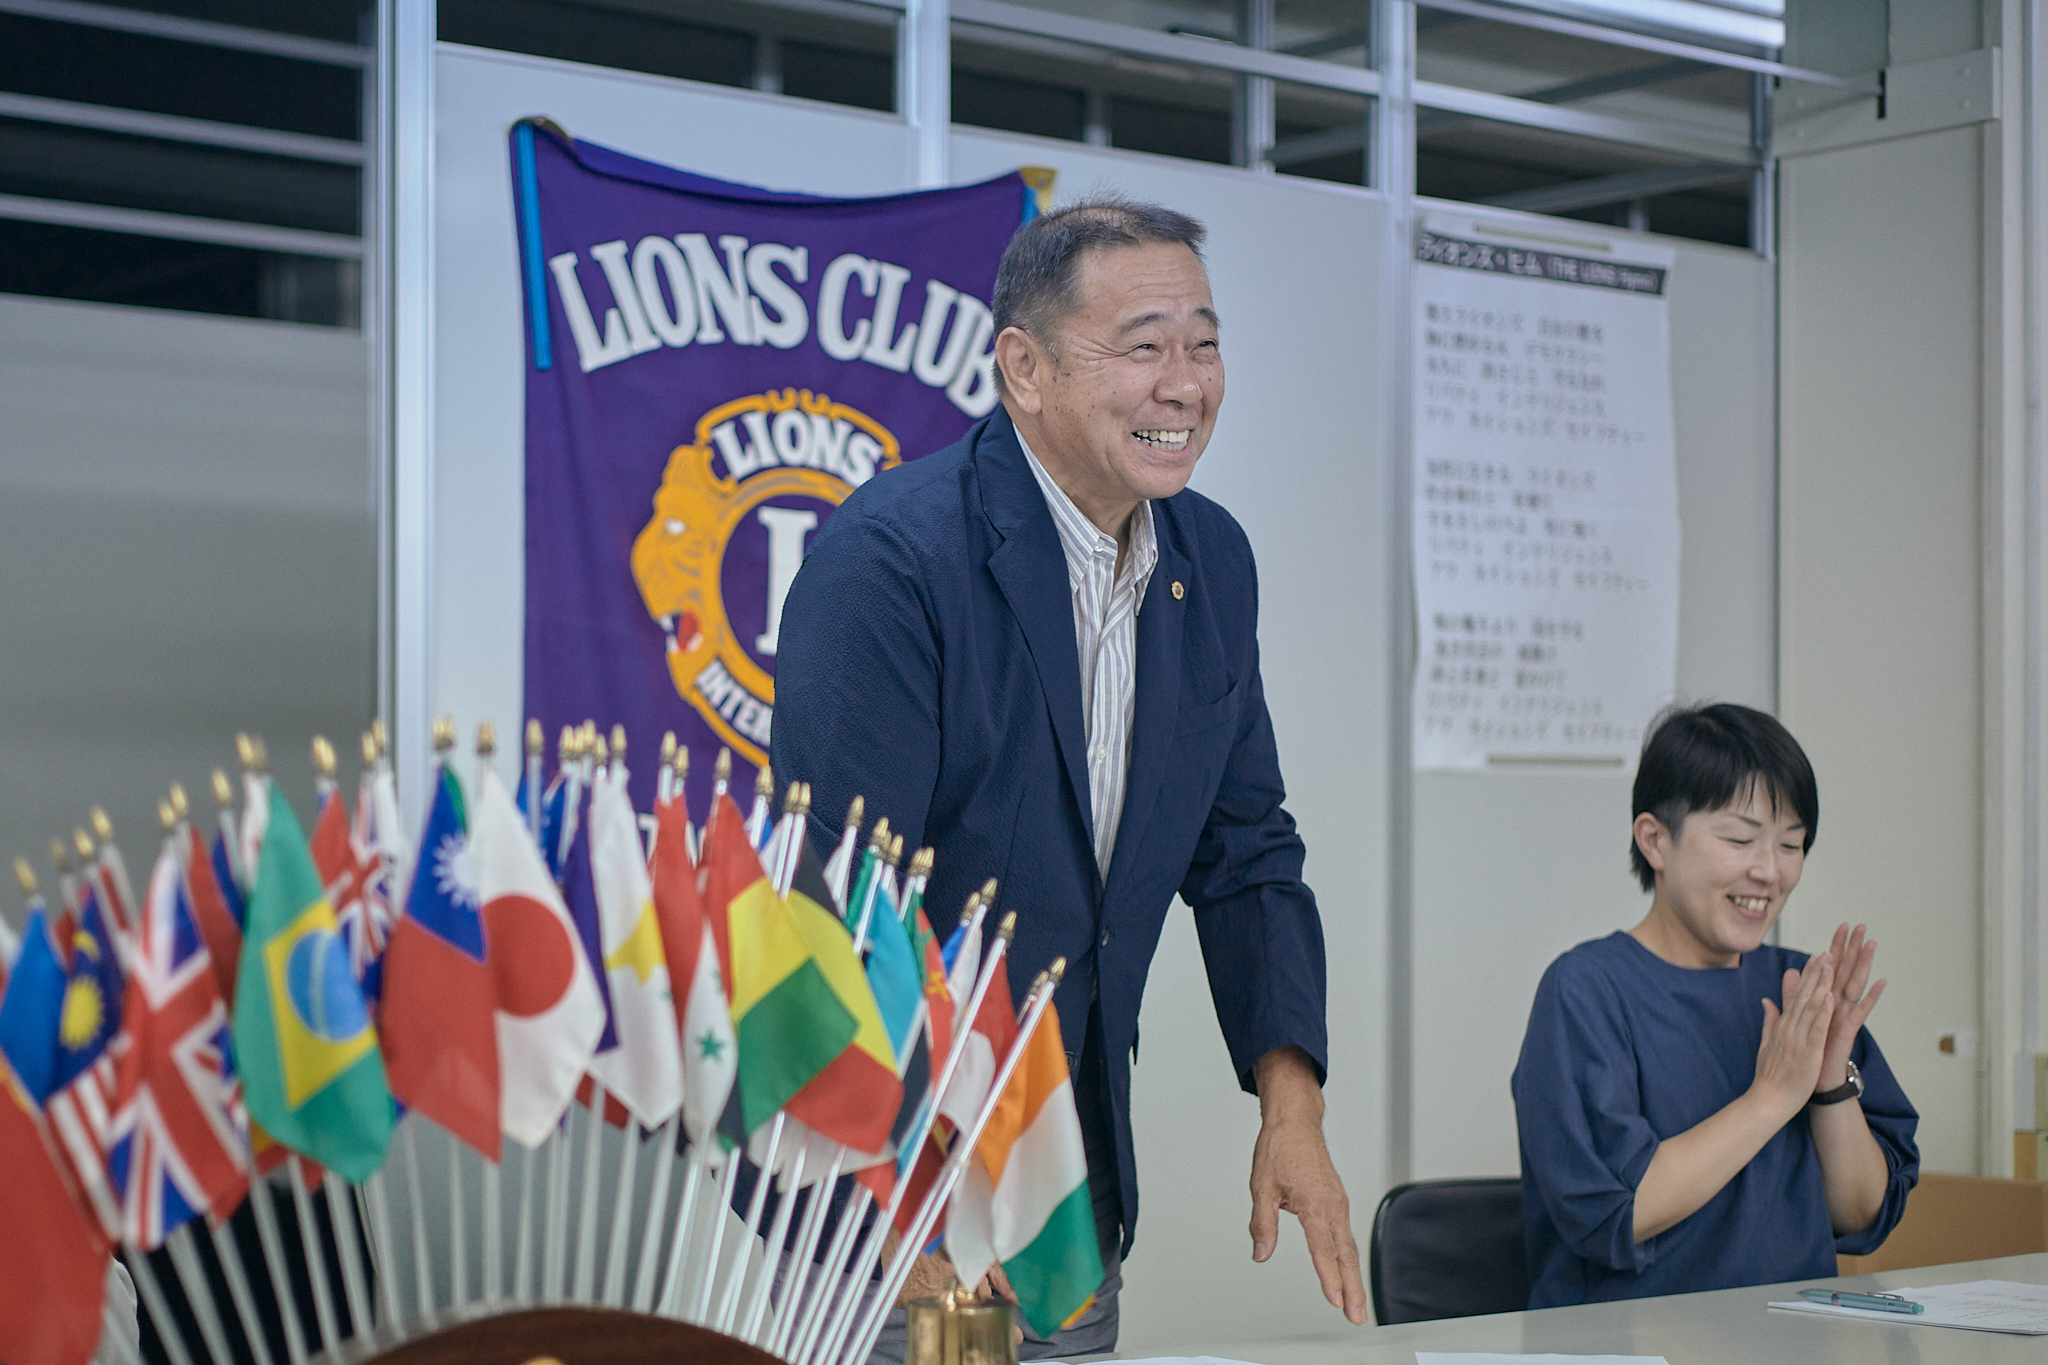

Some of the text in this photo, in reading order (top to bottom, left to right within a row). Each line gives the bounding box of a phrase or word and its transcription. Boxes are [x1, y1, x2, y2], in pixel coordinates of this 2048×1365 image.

[549, 233, 999, 419] LIONS CLUB
[712, 408, 884, 488] LIONS
